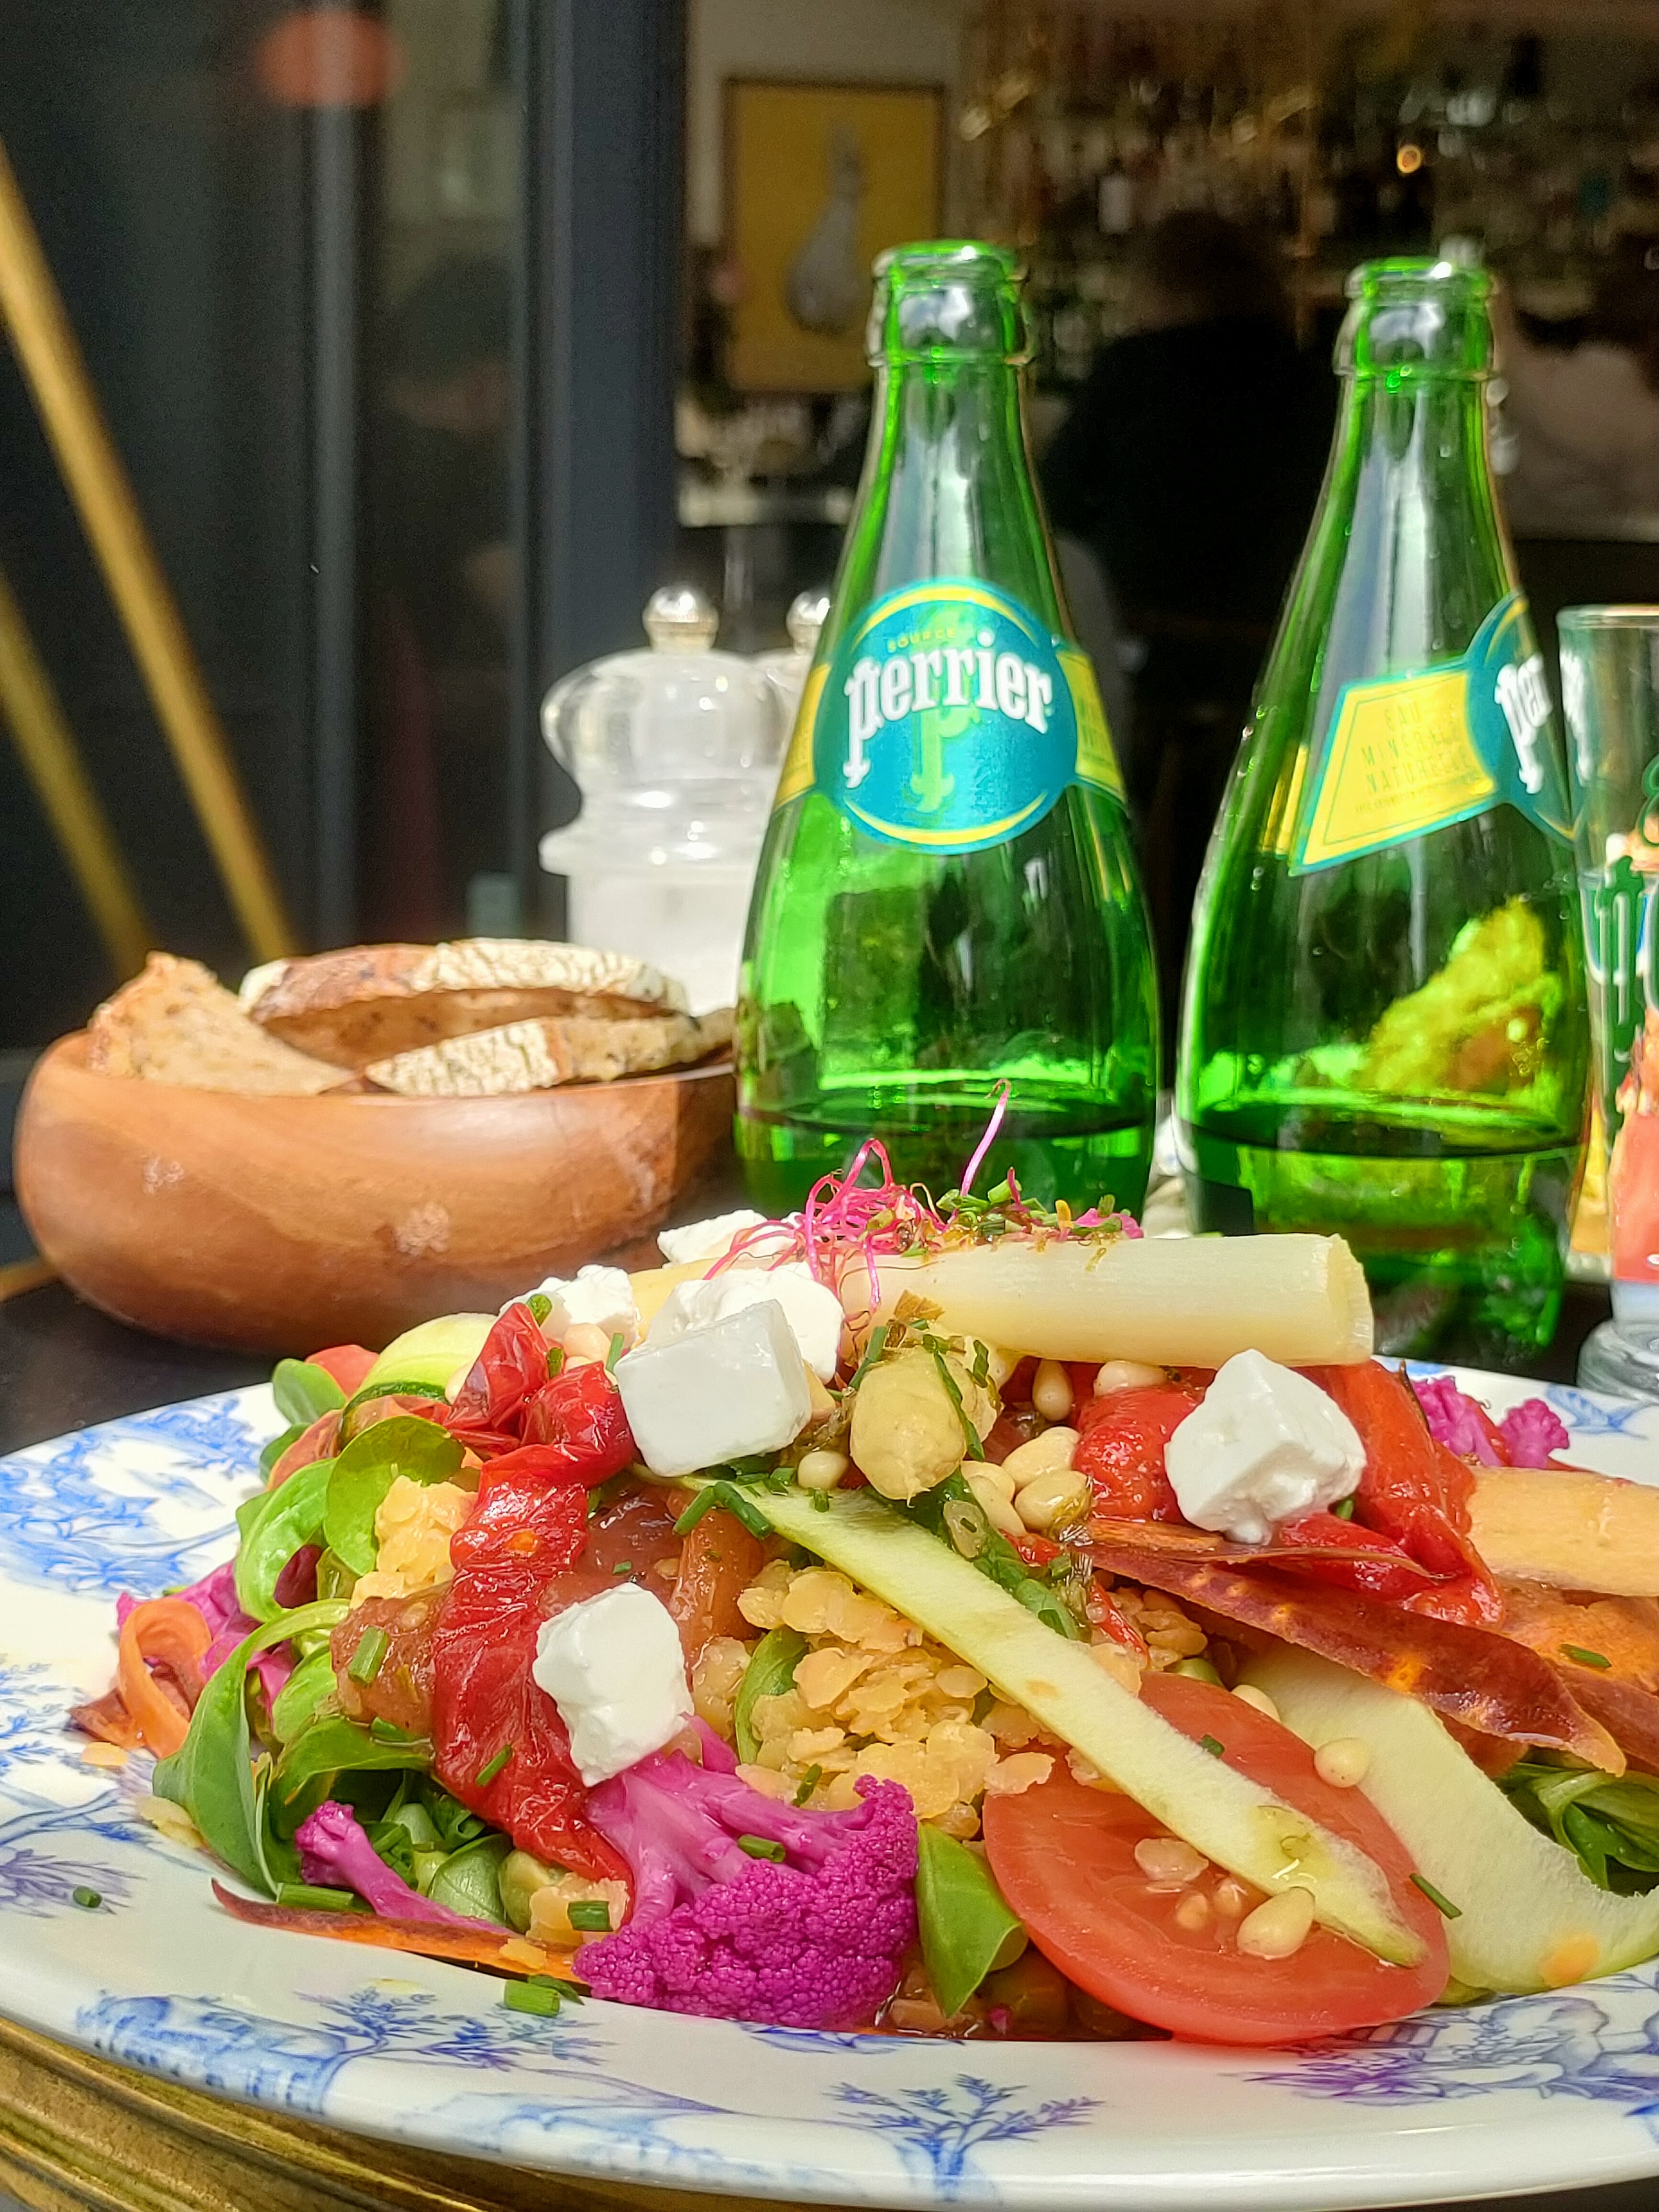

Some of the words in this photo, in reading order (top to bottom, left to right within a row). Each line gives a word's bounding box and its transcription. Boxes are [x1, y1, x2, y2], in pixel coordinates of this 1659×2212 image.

[886, 627, 956, 653] SOURCE
[842, 629, 1052, 788] perrier
[1384, 701, 1421, 732] EAU
